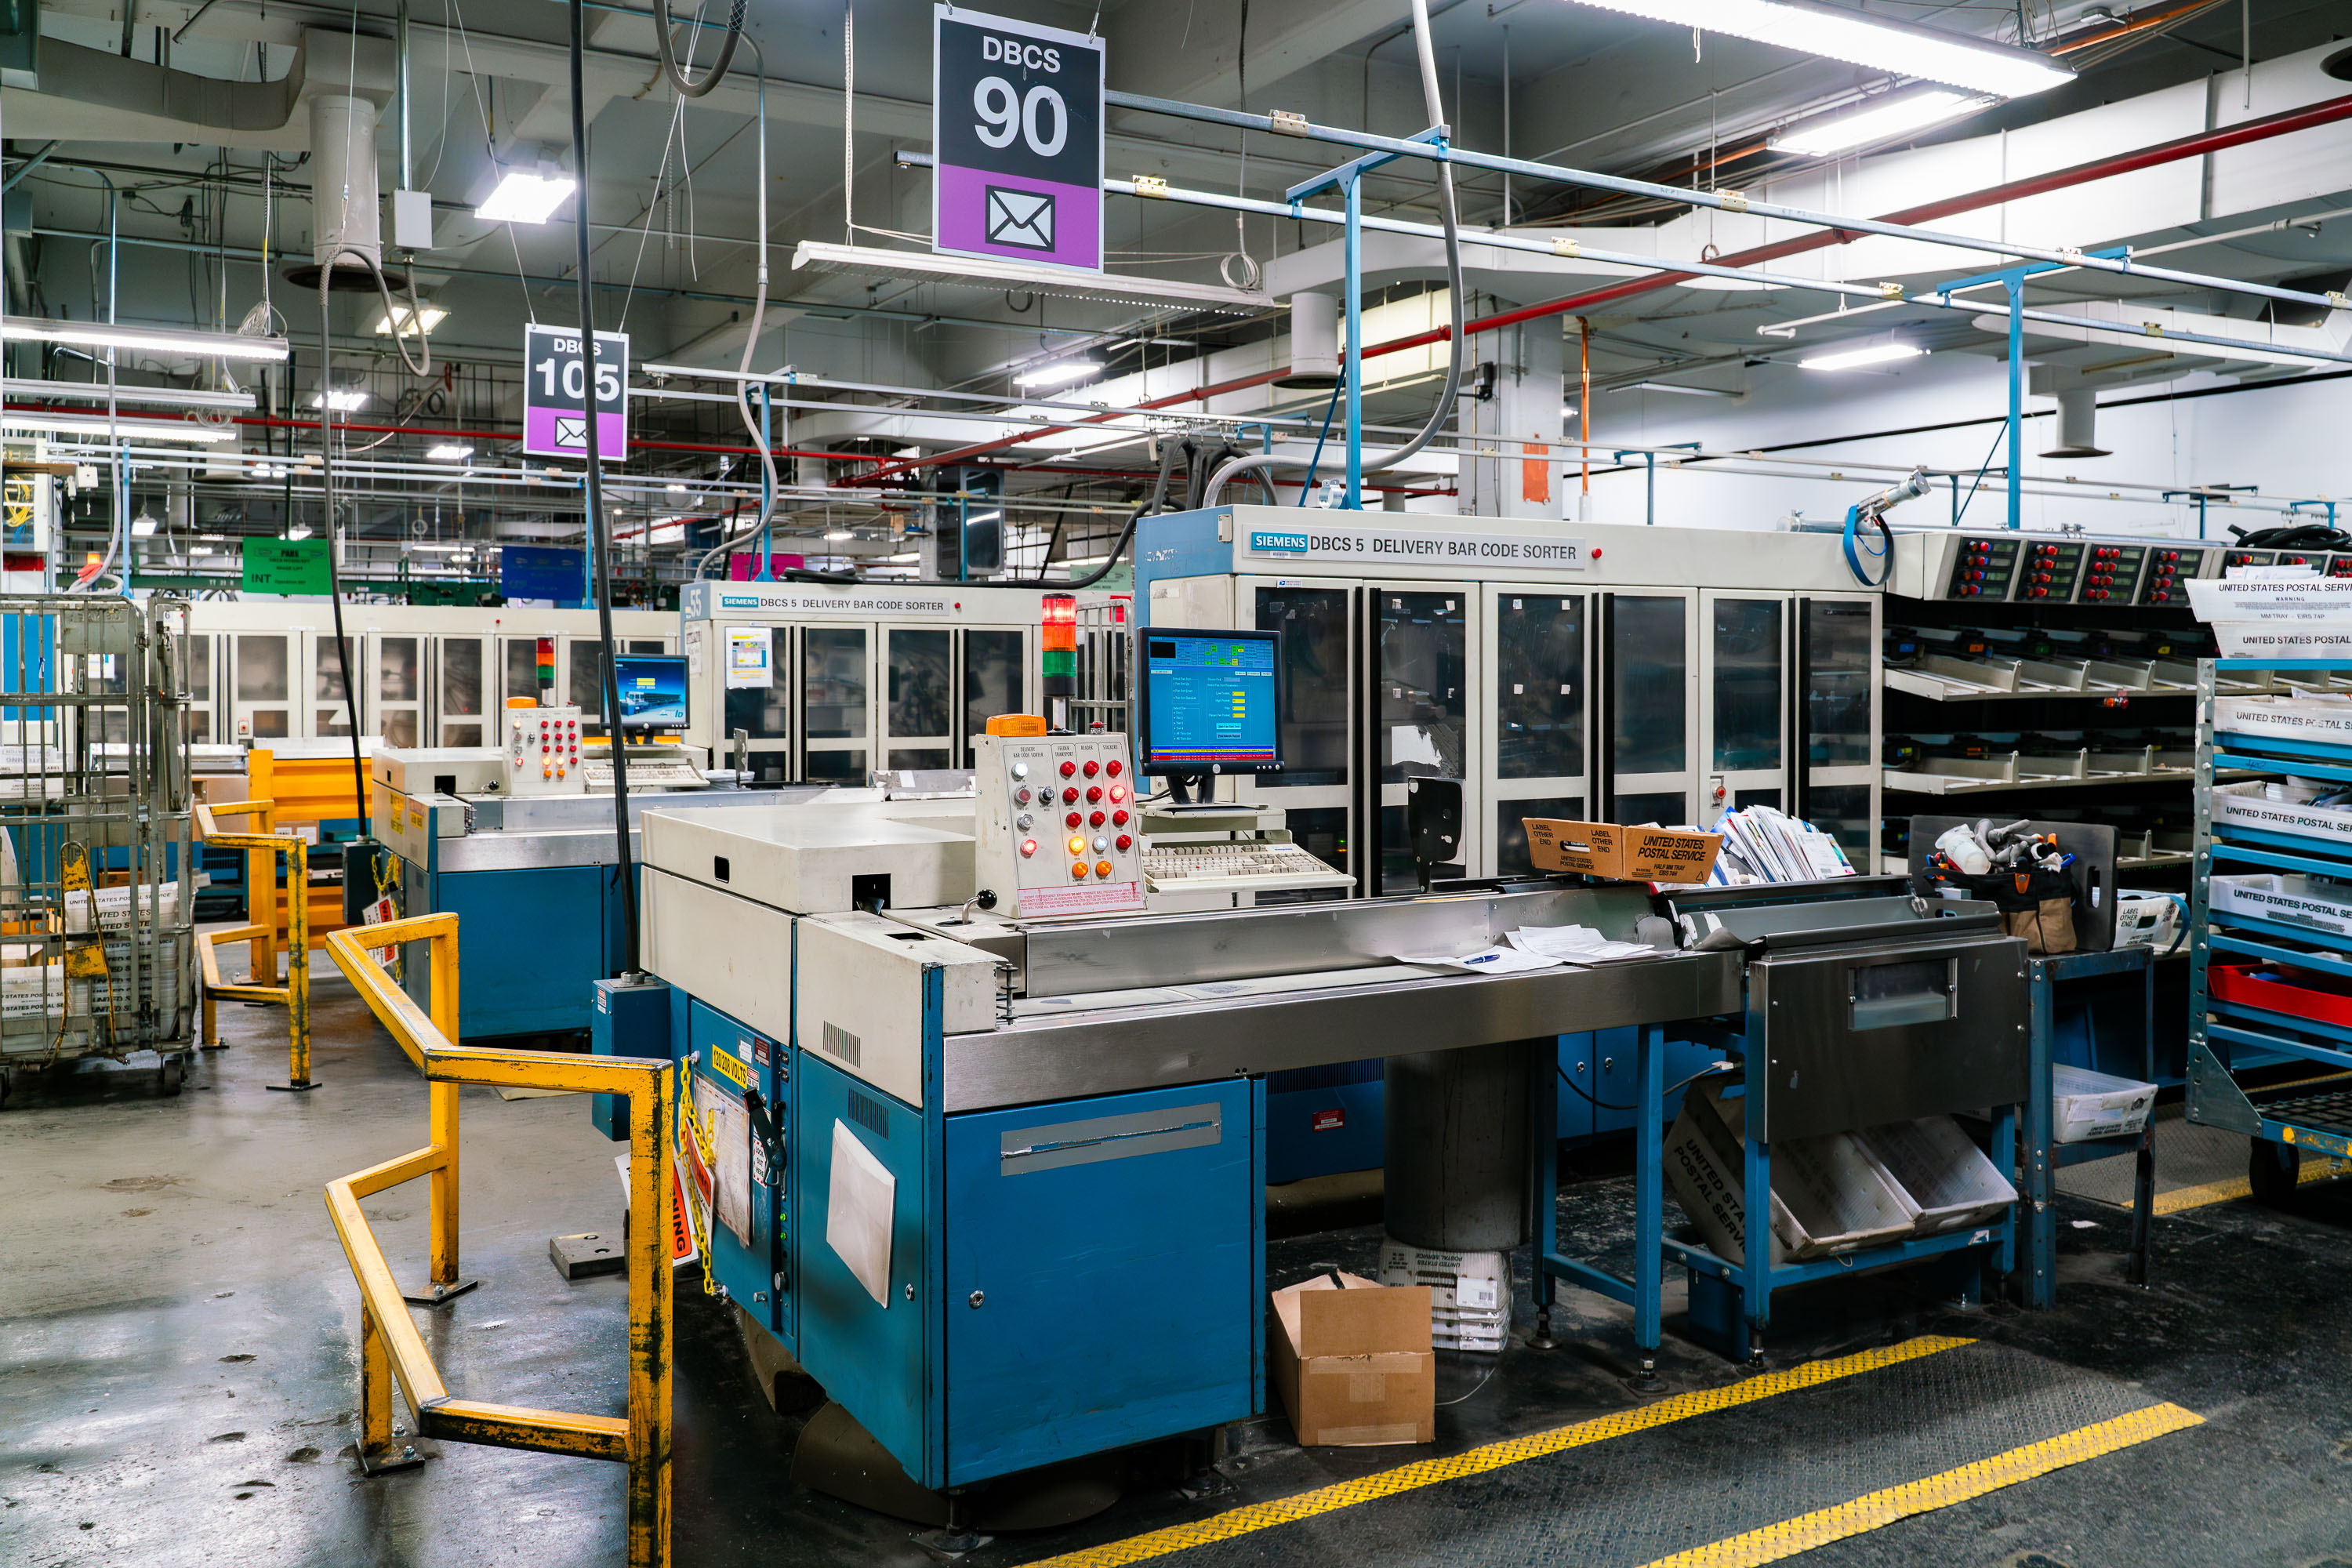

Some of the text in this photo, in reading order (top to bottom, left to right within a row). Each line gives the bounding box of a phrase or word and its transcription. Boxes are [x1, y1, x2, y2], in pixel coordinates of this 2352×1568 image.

[983, 36, 1061, 74] DBCS
[974, 76, 1068, 157] 90
[535, 358, 620, 401] 105
[1255, 535, 1576, 560] SIEMENS DBCS 5 DELIVERY BAR CODE SORTER
[251, 574, 271, 583] INT
[2219, 583, 2249, 592] UNITED
[2250, 583, 2285, 592] STATES
[2286, 583, 2322, 592] POSTAL
[690, 589, 702, 618] 55
[761, 598, 788, 608] DBCS
[791, 599, 797, 608] 5
[803, 599, 851, 609] DELIVERY
[853, 601, 873, 609] BAR
[877, 601, 902, 610] CODE
[906, 601, 943, 610] SORTER
[2237, 711, 2269, 722] UNITED
[2270, 714, 2303, 726] STATES
[2227, 806, 2259, 818] UNITED
[2261, 811, 2295, 824] STATES
[2297, 817, 2334, 829] POSTAL
[1592, 837, 1613, 846] OTHER
[1644, 836, 1704, 850] UNITED STATES
[1638, 847, 1706, 862] POSTAL SERVICE
[2234, 889, 2265, 902] UNITED
[2267, 895, 2299, 909] STATES
[2302, 902, 2338, 916] POSTAL
[731, 1060, 746, 1085] VOLTS
[755, 1167, 764, 1178] HERE
[1686, 1139, 1745, 1223] UNITED STA
[1675, 1146, 1745, 1254] POSTAL SERVI
[673, 1192, 686, 1252] NING
